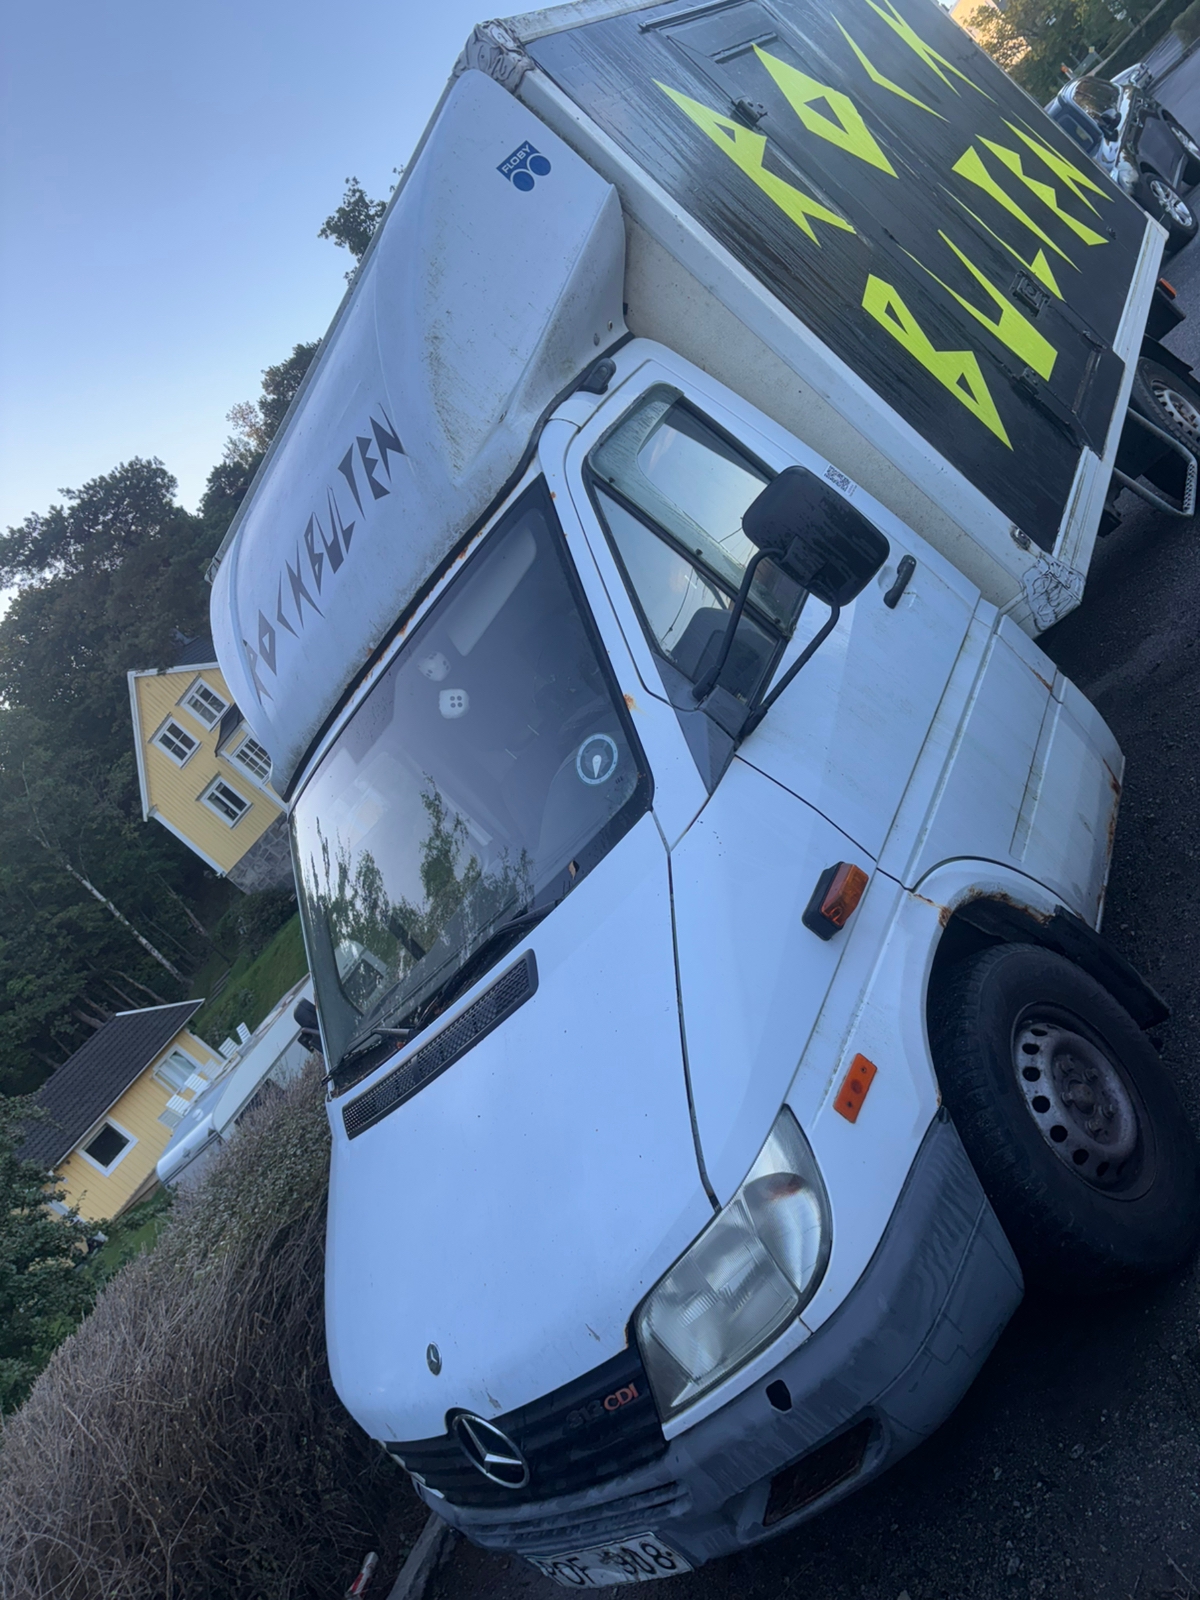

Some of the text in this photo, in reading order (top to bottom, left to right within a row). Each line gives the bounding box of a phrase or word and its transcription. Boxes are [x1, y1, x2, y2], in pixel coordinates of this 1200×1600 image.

[501, 144, 531, 174] FLOBY
[652, 0, 997, 248] ROCK
[862, 111, 1114, 451] BULTEN
[242, 402, 408, 706] ROCKBULTEN
[604, 1382, 639, 1411] CDI
